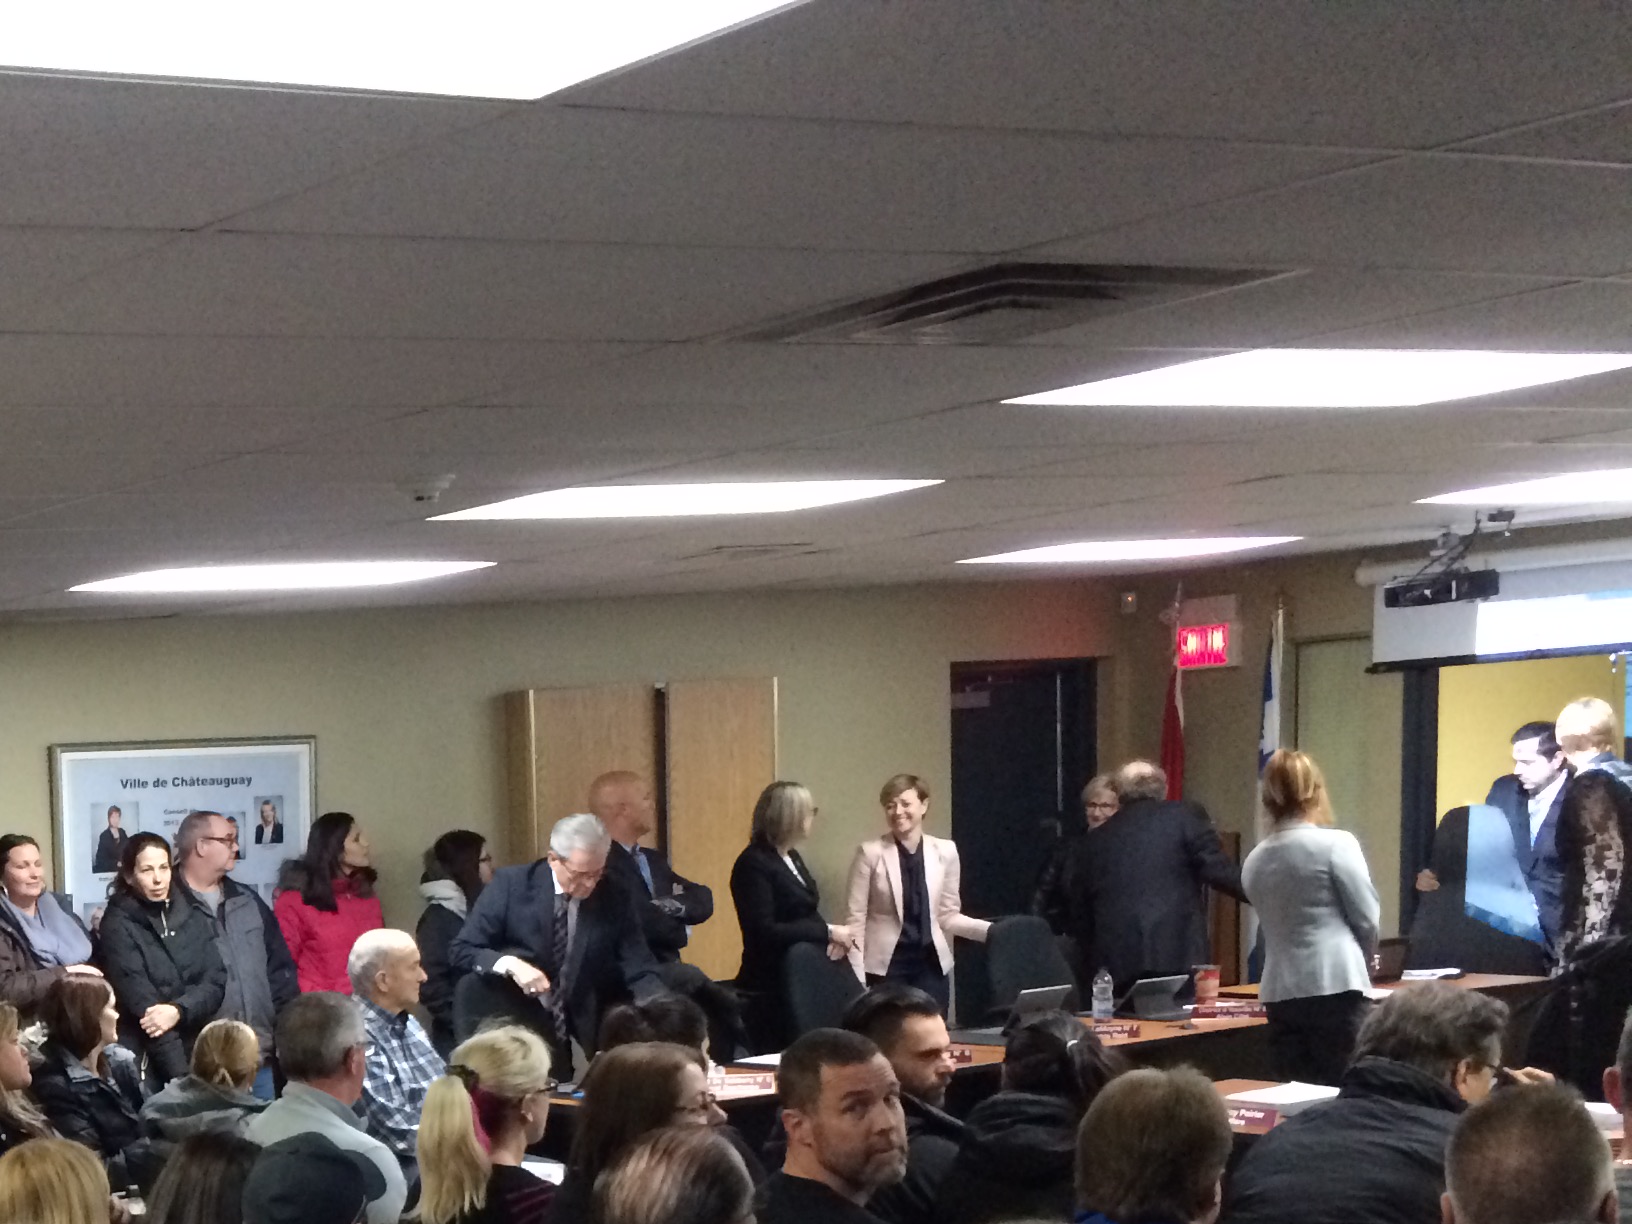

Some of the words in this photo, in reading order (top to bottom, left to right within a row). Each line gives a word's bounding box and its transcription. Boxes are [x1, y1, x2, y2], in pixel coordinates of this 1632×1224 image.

[120, 778, 149, 789] Ville
[152, 777, 168, 788] de
[171, 776, 253, 788] Châteauguay
